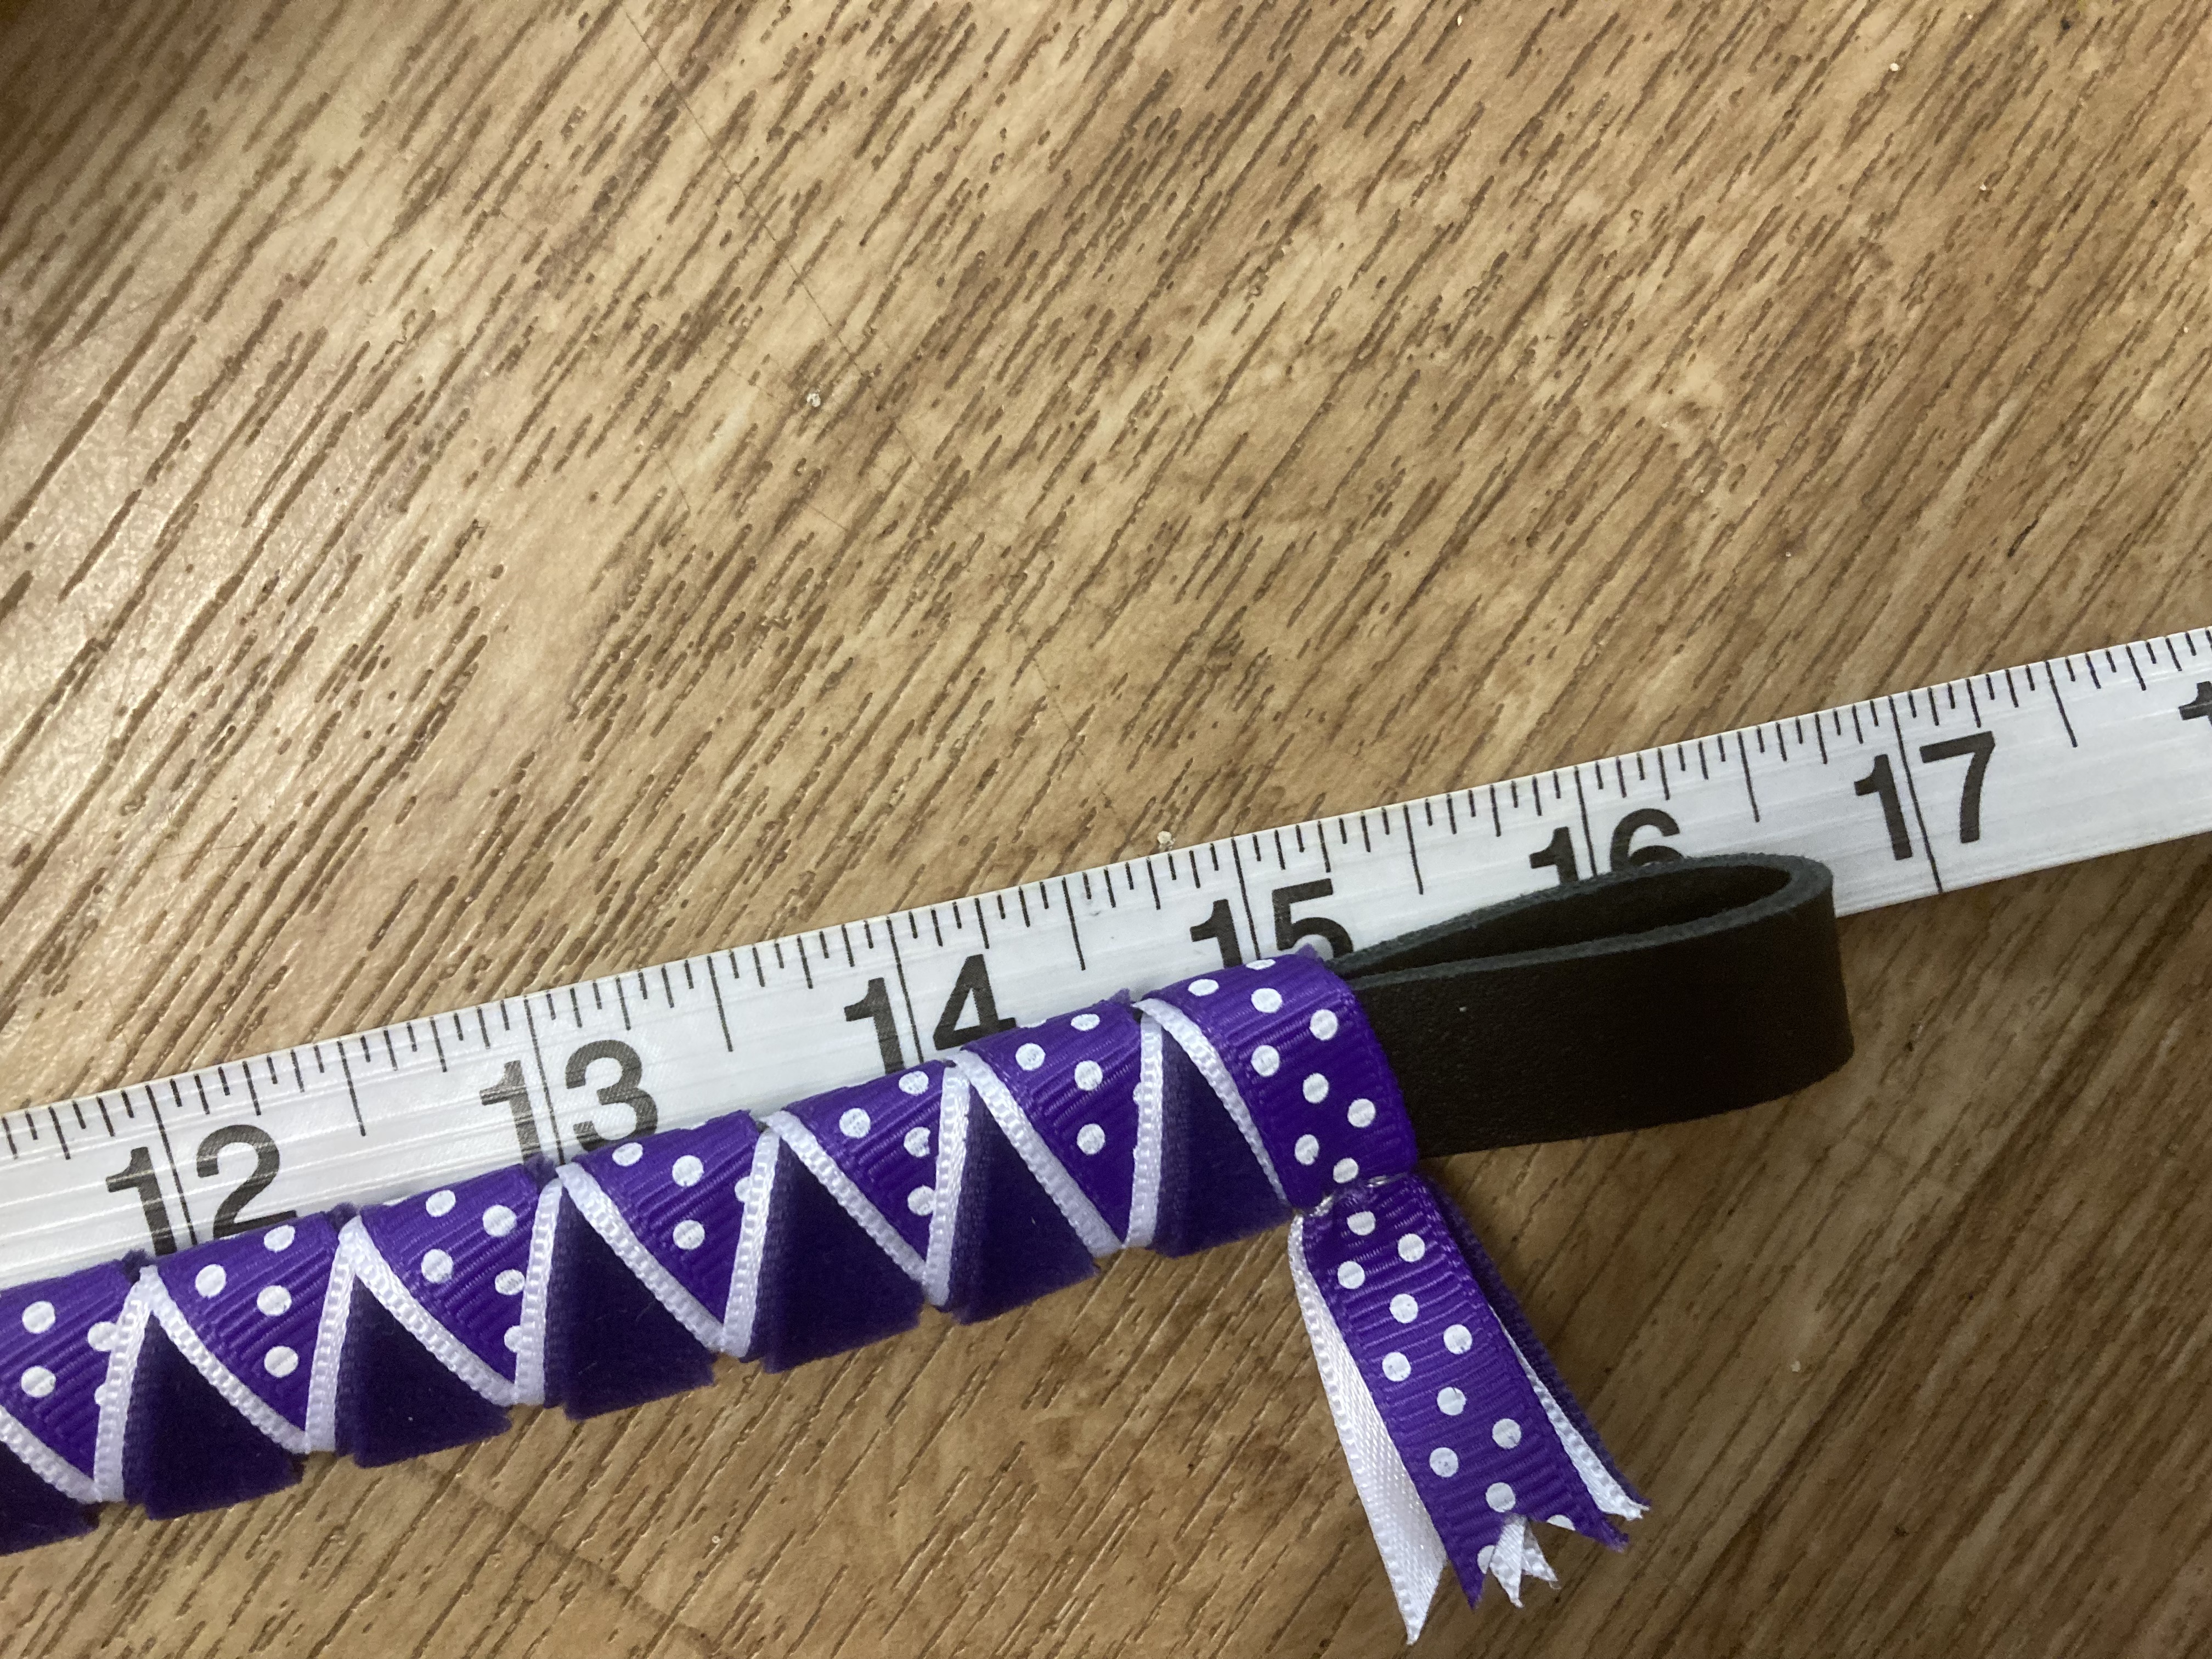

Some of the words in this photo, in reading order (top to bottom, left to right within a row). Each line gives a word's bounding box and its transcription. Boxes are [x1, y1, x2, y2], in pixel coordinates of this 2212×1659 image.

[106, 1124, 297, 1255] 12
[479, 1040, 658, 1162] 13
[844, 954, 1017, 1074] 14
[1190, 878, 1354, 969] 15
[1854, 731, 1995, 861] 17
